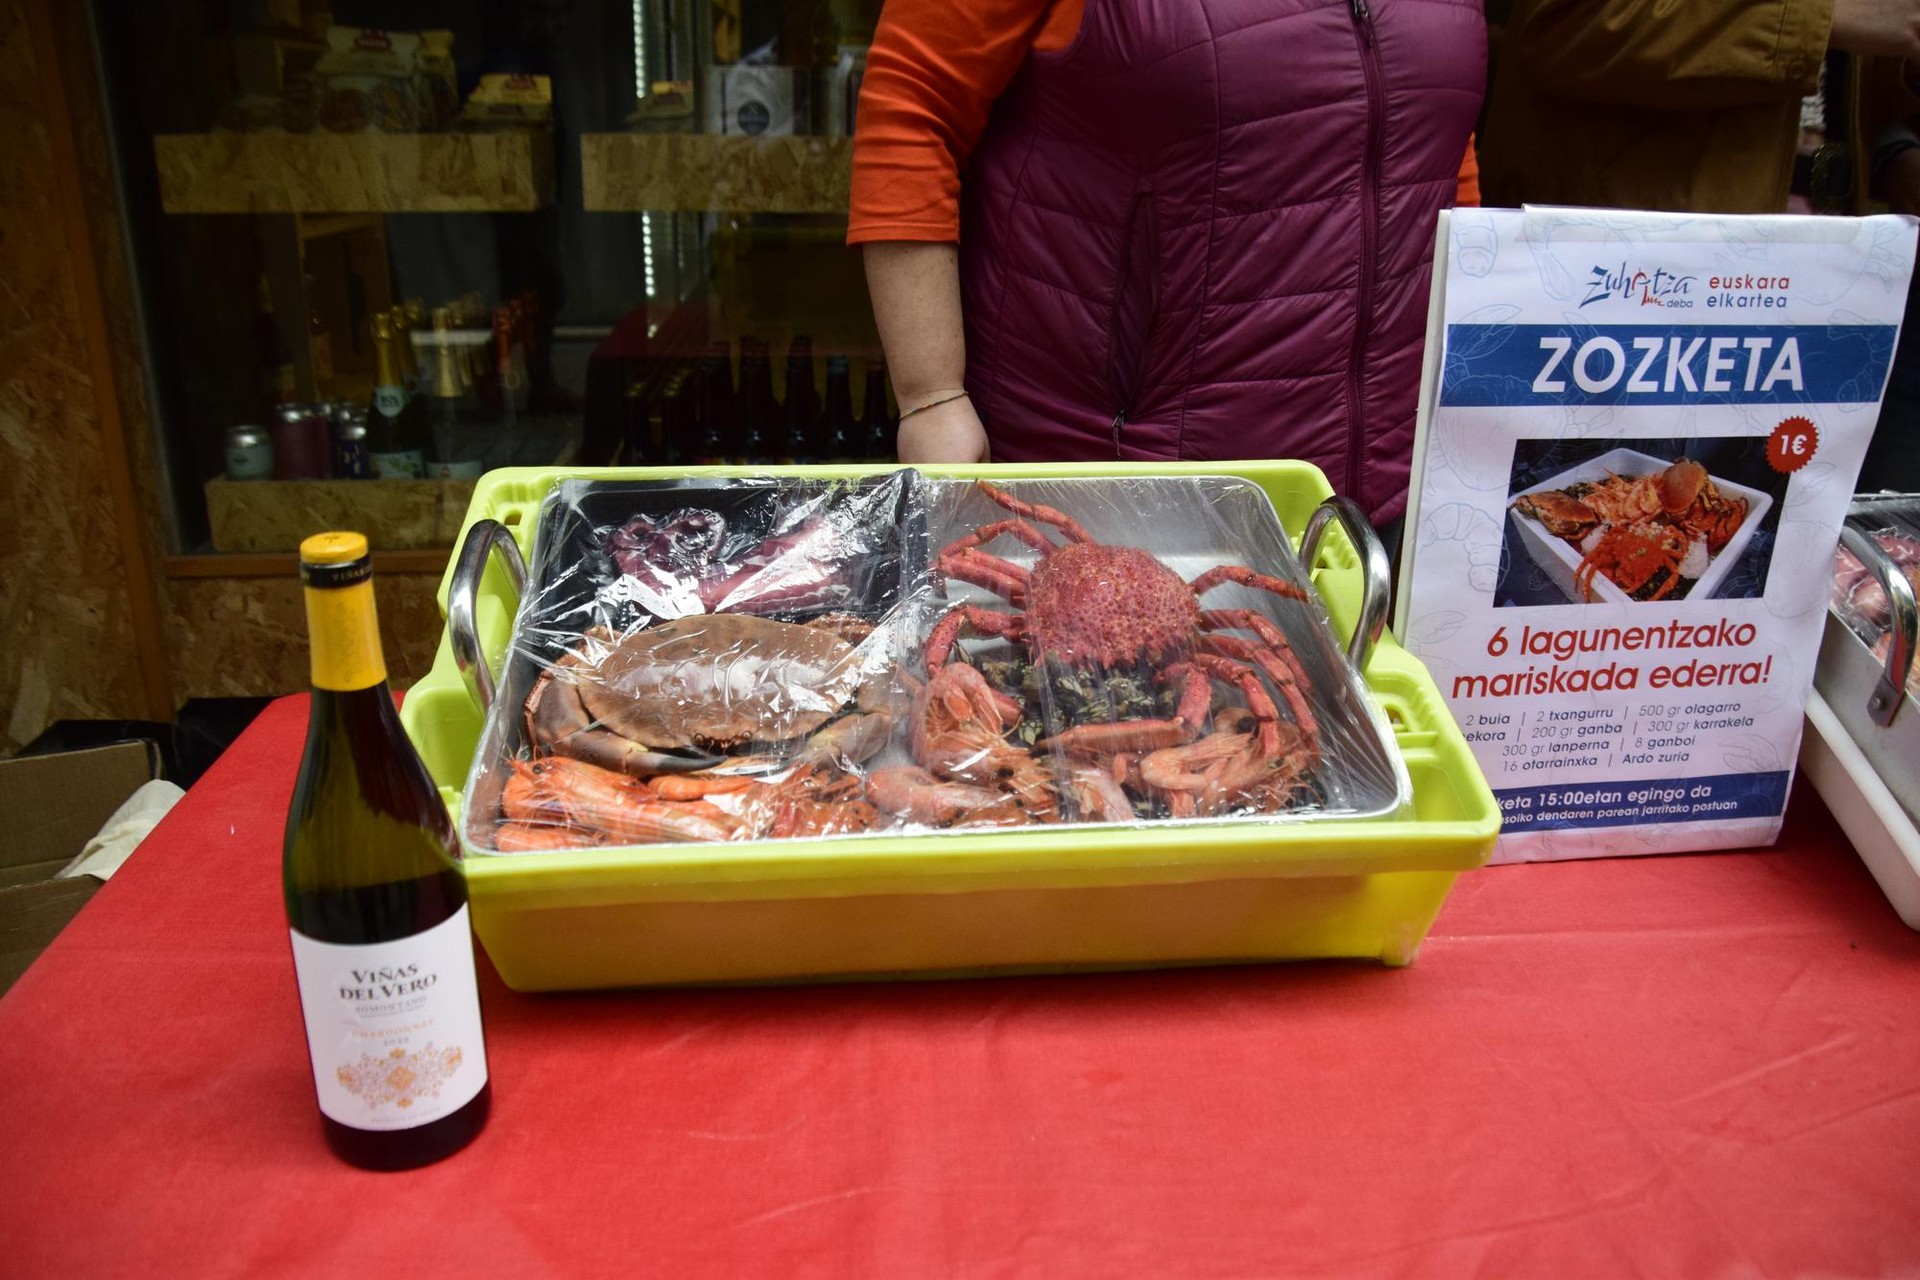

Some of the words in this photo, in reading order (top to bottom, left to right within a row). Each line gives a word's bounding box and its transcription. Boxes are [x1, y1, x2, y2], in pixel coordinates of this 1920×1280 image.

[1708, 273, 1790, 290] euskara
[1666, 298, 1694, 308] deba
[1706, 293, 1788, 308] elkartea
[1531, 336, 1805, 394] ZOZKETA
[1780, 434, 1808, 456] 1€
[1487, 626, 1508, 657] 6
[1520, 618, 1757, 661] lagunentzako
[1452, 662, 1639, 699] mariskada
[1649, 655, 1773, 689] ederra!
[1465, 714, 1475, 727] 2
[1478, 714, 1511, 726] buia
[1536, 710, 1545, 723] 2
[1549, 707, 1614, 726] txangurru
[1638, 704, 1664, 717] 500
[1667, 706, 1682, 720] gr
[1684, 702, 1742, 717] olagarro
[1462, 731, 1506, 742] ekora
[1531, 726, 1556, 739] 200
[1560, 729, 1573, 743] gr
[1577, 723, 1623, 738] ganba
[1647, 720, 1673, 733] 300
[1676, 722, 1690, 736] gr
[1693, 716, 1754, 731] karrakela
[1502, 744, 1527, 757] 300
[1531, 746, 1545, 760] gr
[1548, 739, 1610, 756] lanperna
[1635, 737, 1643, 749] 8
[1647, 734, 1696, 751] ganboi
[1503, 761, 1518, 773] 16
[1522, 756, 1598, 771] otarrainxka
[1622, 753, 1654, 765] Ardo
[1658, 752, 1690, 763] zuria
[1496, 795, 1532, 811] keta
[1539, 791, 1622, 807] 15:00etan
[1627, 788, 1686, 805] egingo
[1690, 784, 1712, 799] da
[1502, 812, 1534, 825] soiko
[1536, 809, 1594, 822] dendaren
[1596, 807, 1639, 821] parean
[1641, 802, 1690, 818] jarritako
[1692, 799, 1738, 814] postuan
[351, 963, 418, 985] VIÑAS
